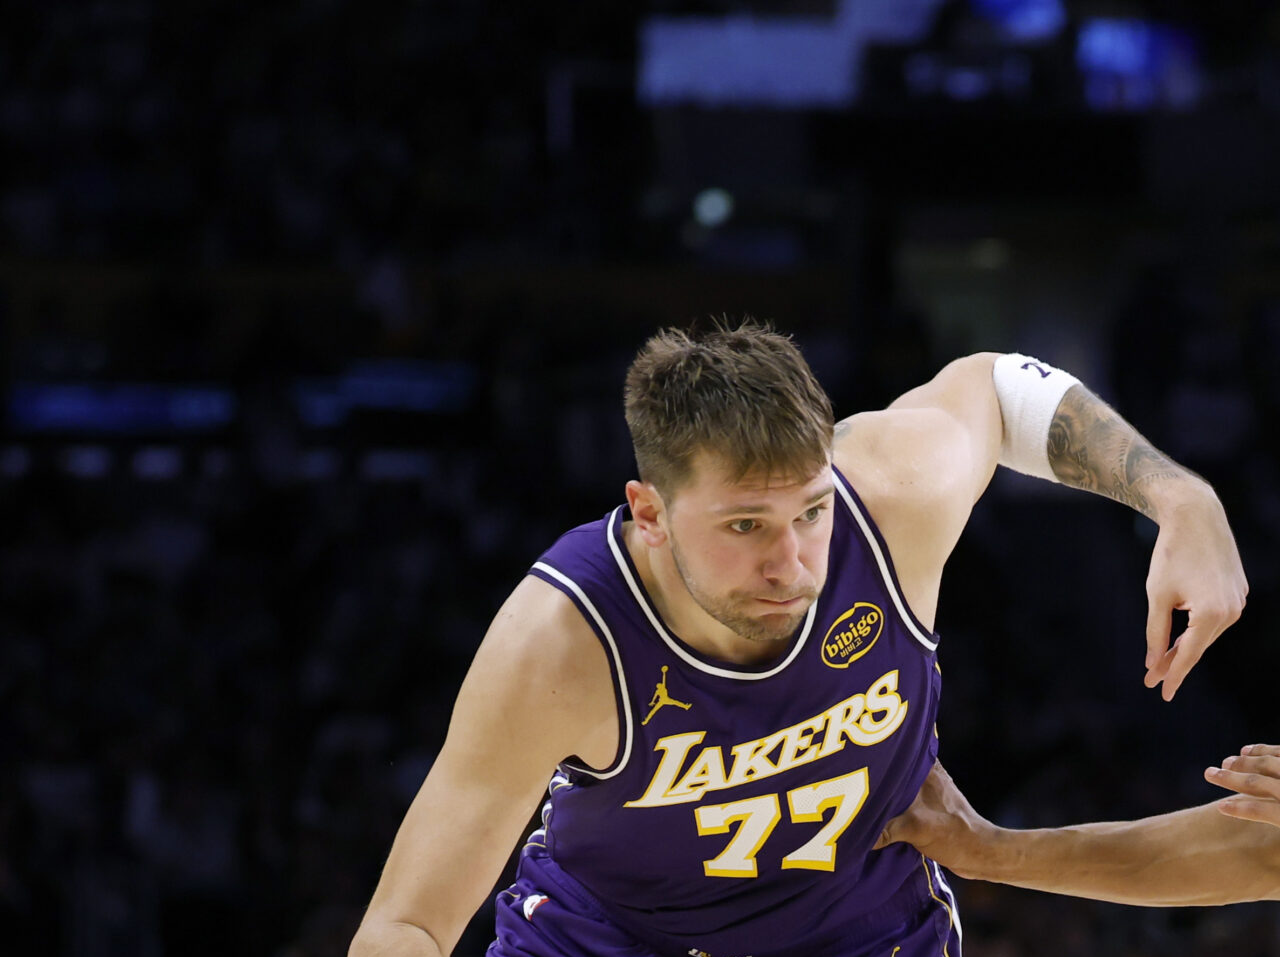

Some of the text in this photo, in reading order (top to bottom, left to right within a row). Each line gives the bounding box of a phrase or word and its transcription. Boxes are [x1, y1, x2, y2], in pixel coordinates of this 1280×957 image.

[826, 611, 879, 657] bibigo
[623, 669, 908, 807] LAKERS
[694, 767, 869, 878] 77
